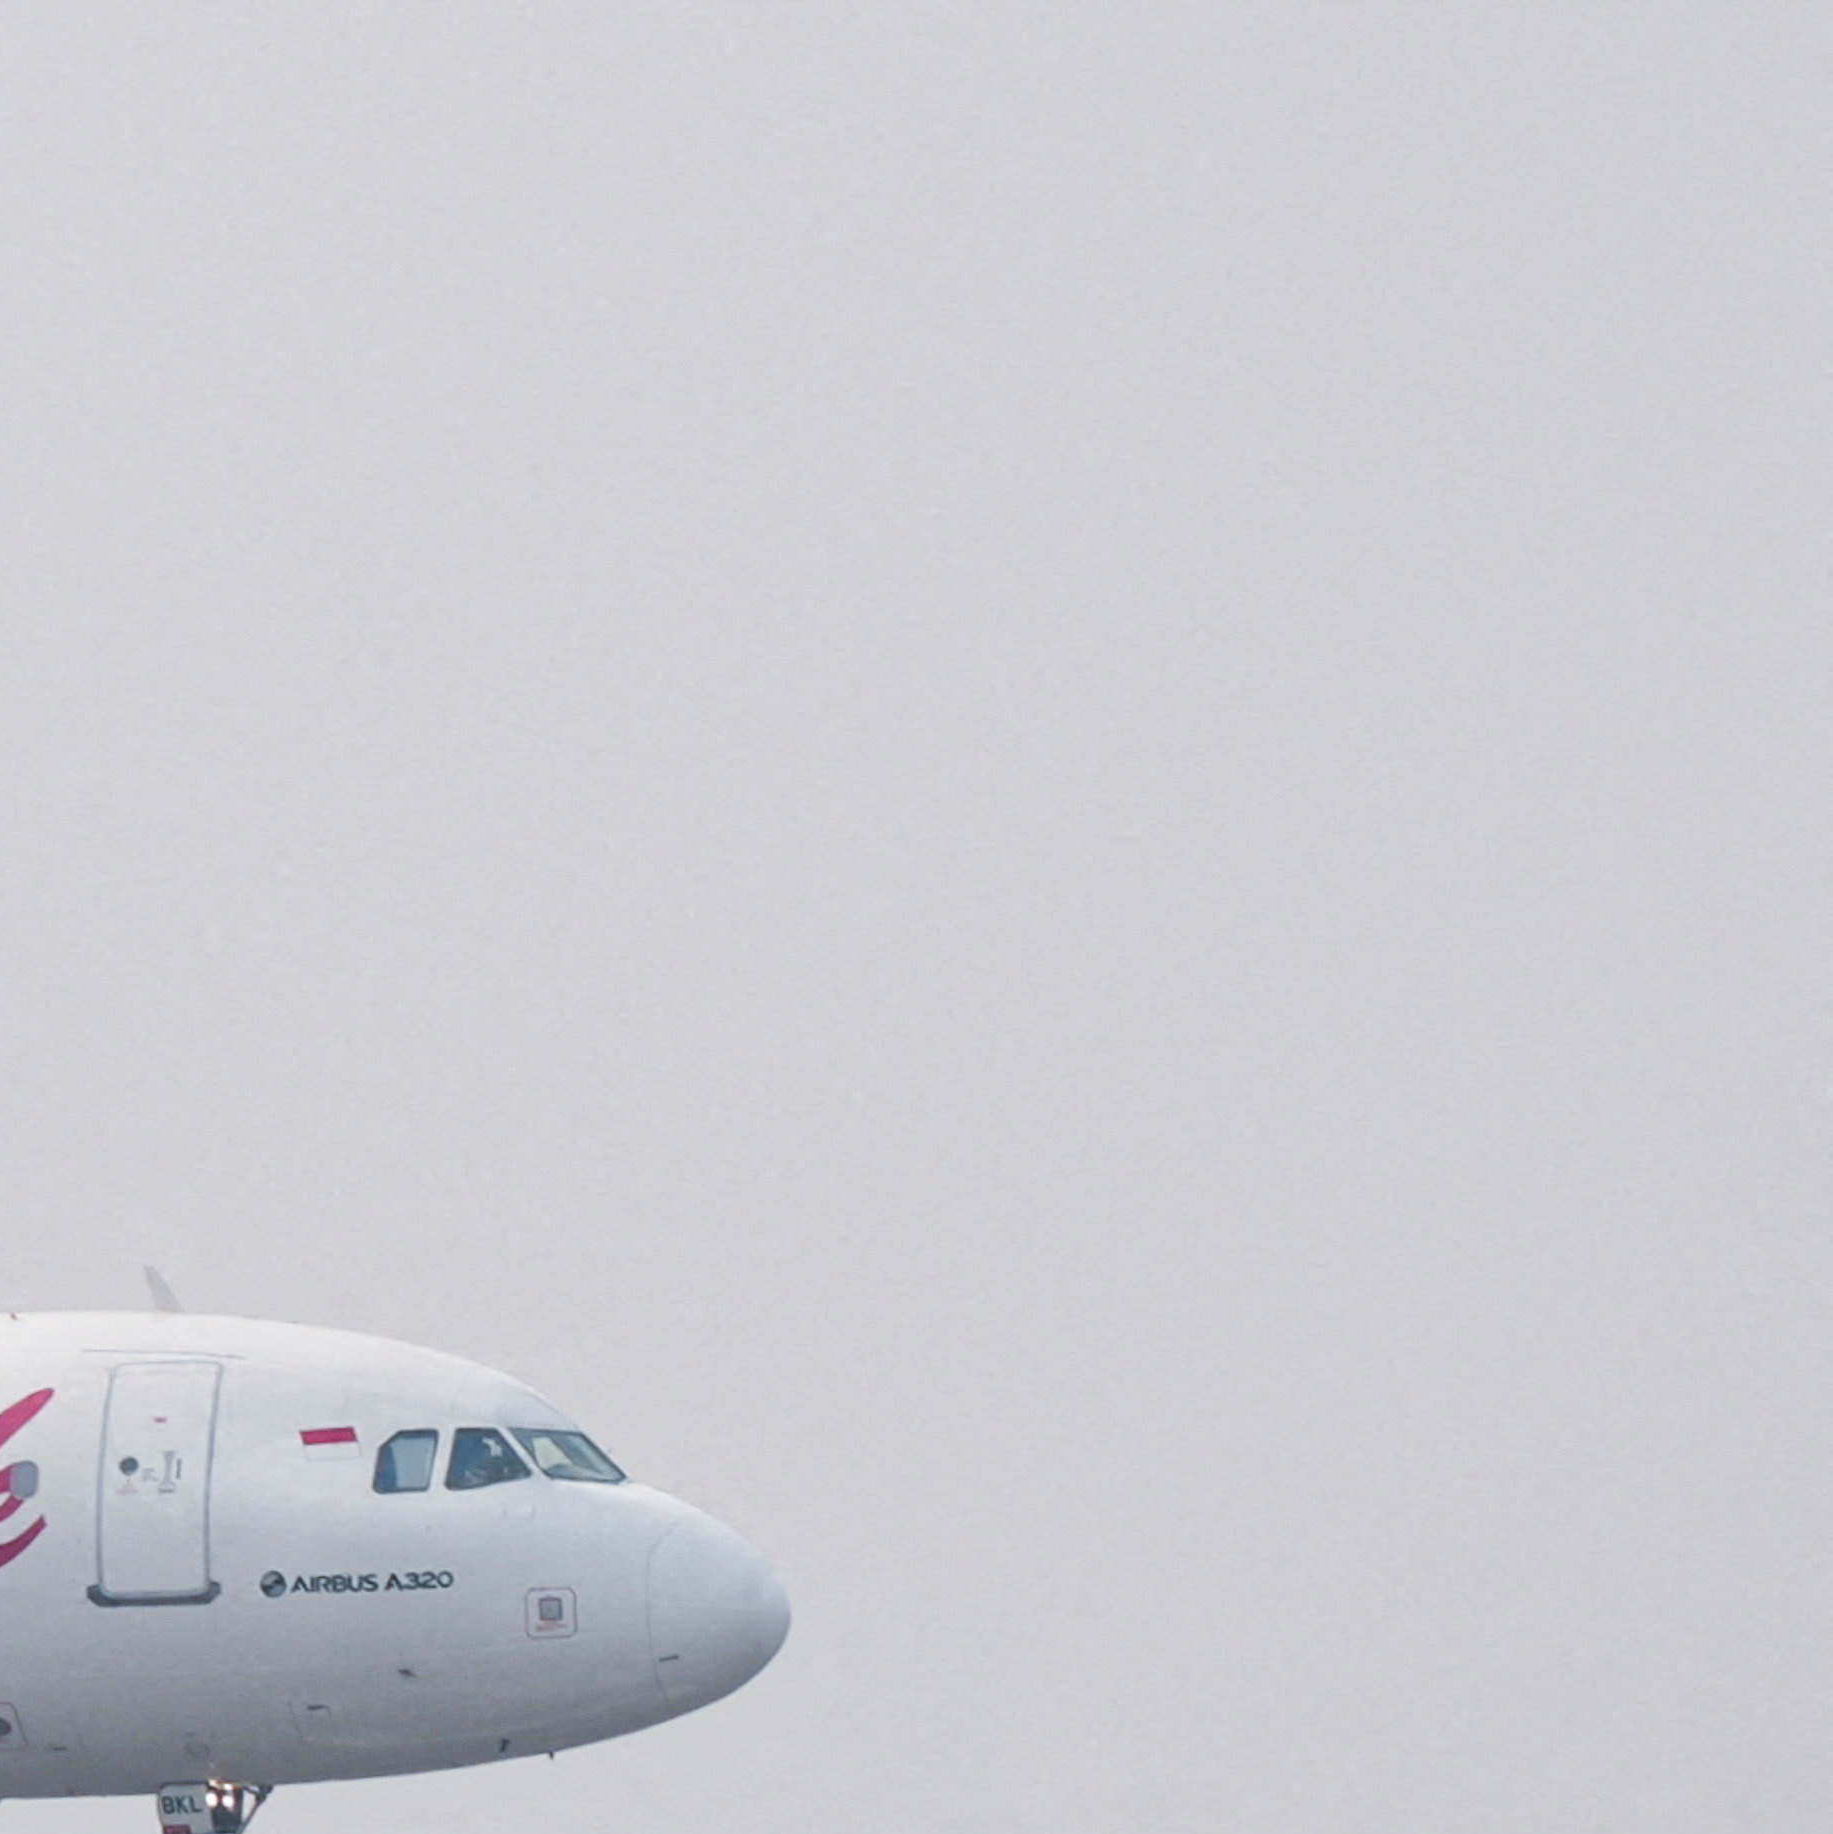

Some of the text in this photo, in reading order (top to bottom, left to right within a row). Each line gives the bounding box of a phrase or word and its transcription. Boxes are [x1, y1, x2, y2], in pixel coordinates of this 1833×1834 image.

[290, 1570, 454, 1593] AIRBUS A320
[162, 1795, 203, 1815] BKL
